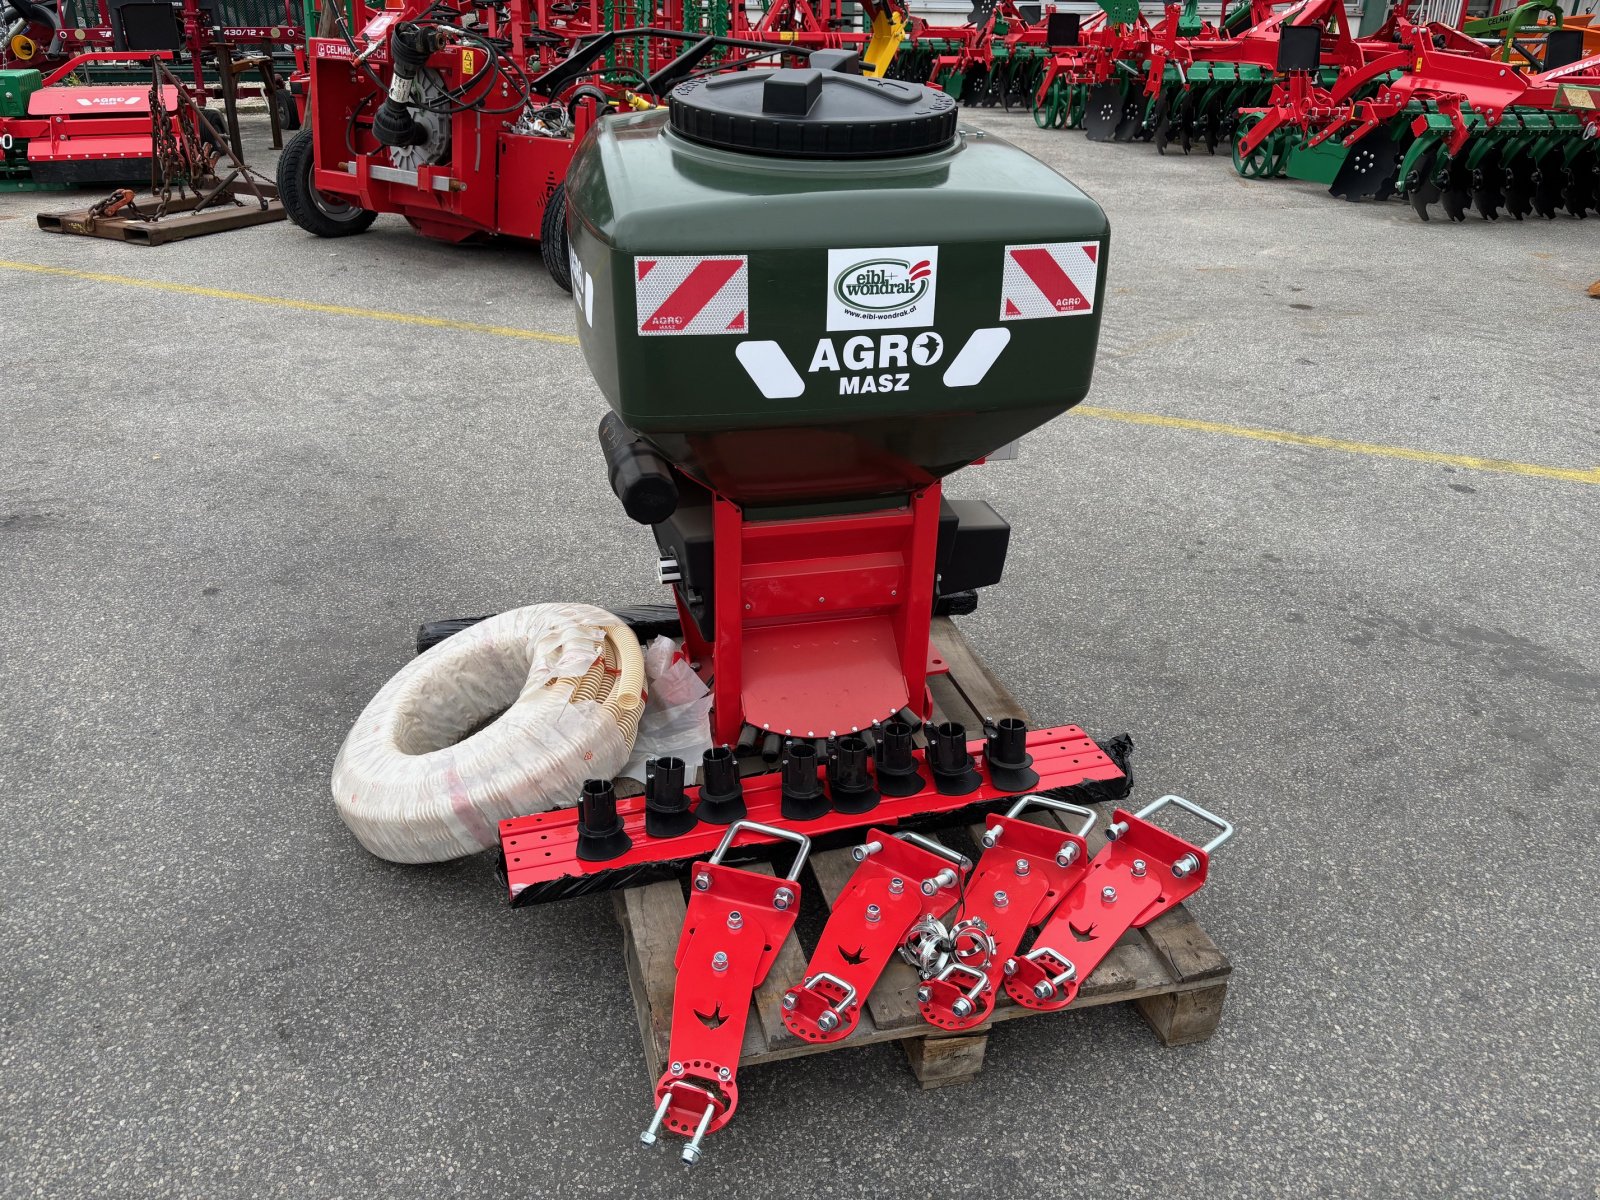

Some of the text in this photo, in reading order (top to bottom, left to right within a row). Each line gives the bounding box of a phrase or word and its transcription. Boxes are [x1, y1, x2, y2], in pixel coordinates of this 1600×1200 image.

[846, 279, 915, 296] wondrak
[1055, 297, 1081, 306] AGRO
[652, 316, 683, 325] AGRO
[844, 305, 917, 320] www.eibl-wondrak.at
[808, 331, 944, 373] AGRO
[839, 372, 910, 395] MASZ
